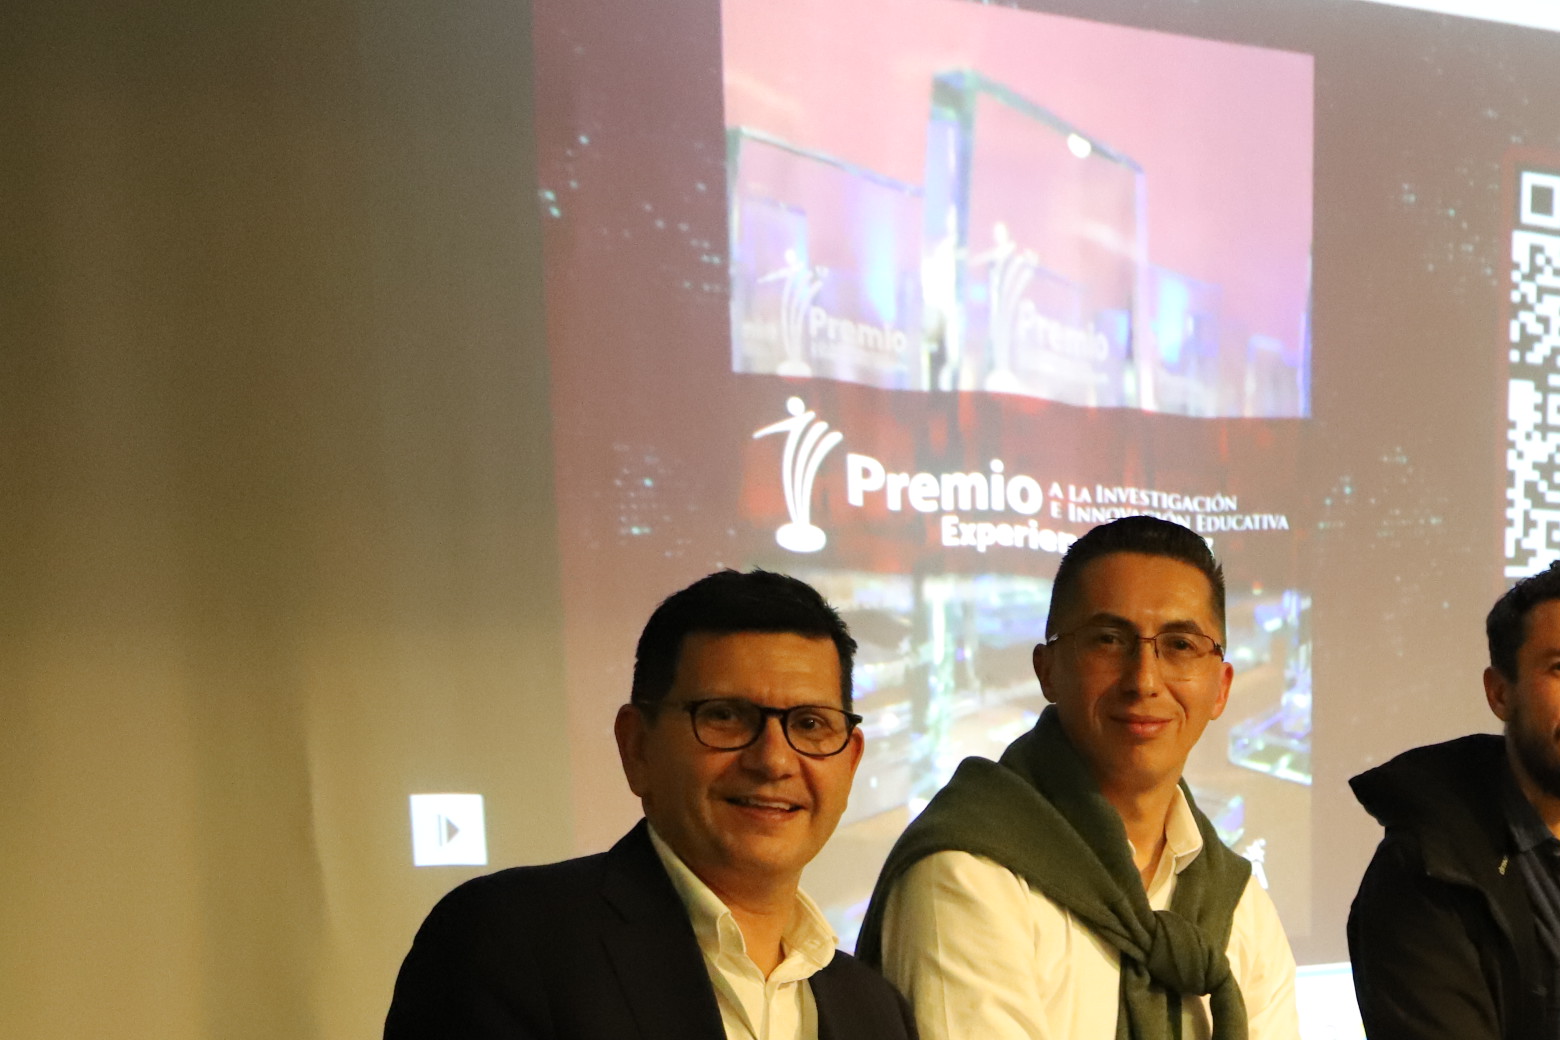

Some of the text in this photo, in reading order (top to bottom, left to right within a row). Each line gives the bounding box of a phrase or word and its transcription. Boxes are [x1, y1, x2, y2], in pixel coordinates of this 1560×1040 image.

[809, 305, 907, 351] Premio
[1018, 299, 1109, 362] Premio
[846, 453, 1043, 515] Premio
[1049, 482, 1237, 512] A LA INVESTIGACIÓN
[1050, 501, 1062, 518] E
[1197, 513, 1289, 533] EDUCATIVA
